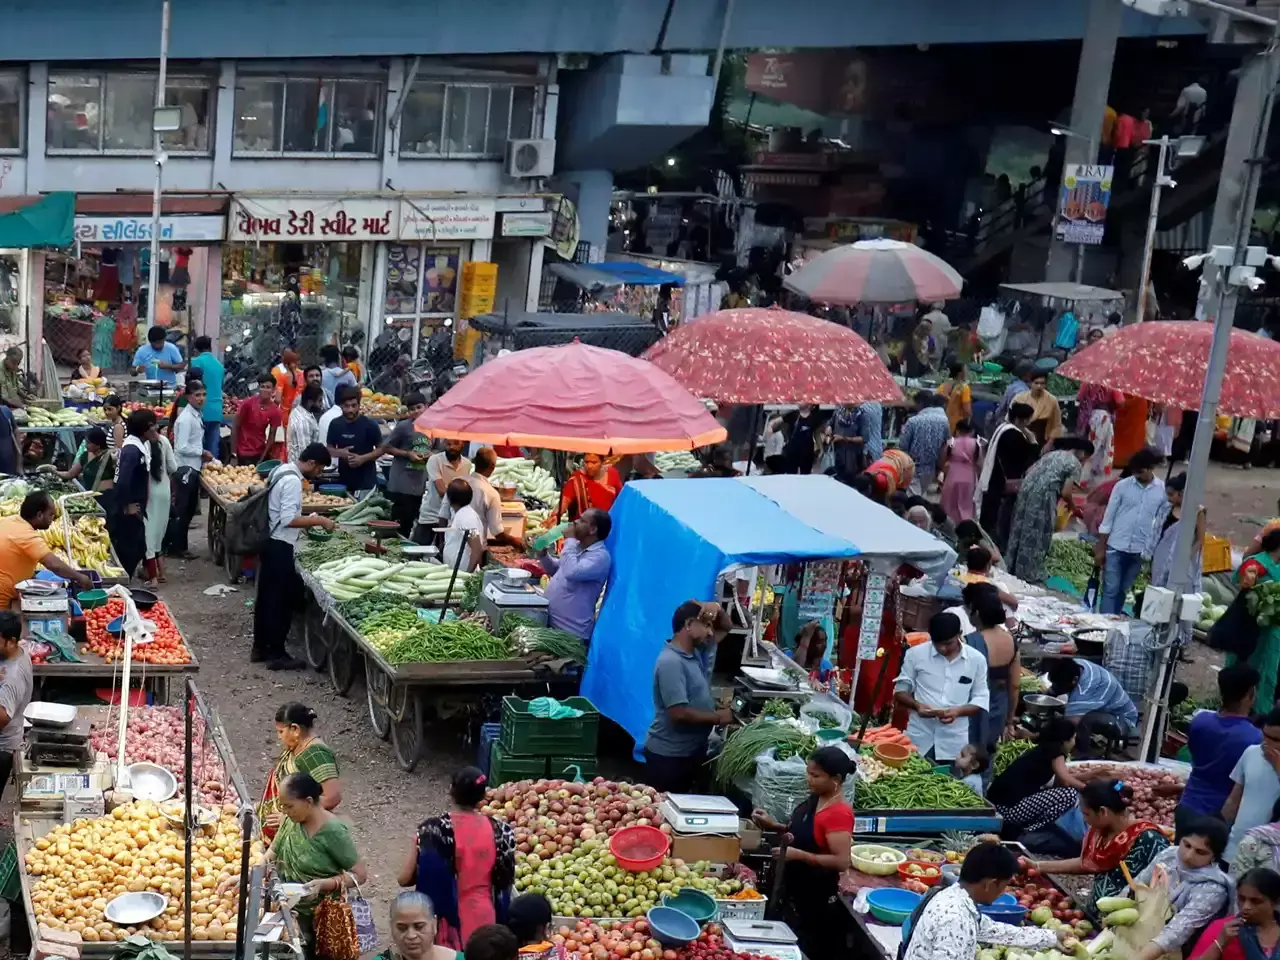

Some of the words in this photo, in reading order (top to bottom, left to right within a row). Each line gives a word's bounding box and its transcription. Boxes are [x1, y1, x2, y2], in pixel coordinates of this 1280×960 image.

[287, 209, 315, 235] ડેરી
[320, 210, 357, 235] સ્વીટ
[362, 210, 393, 235] માર્ટ
